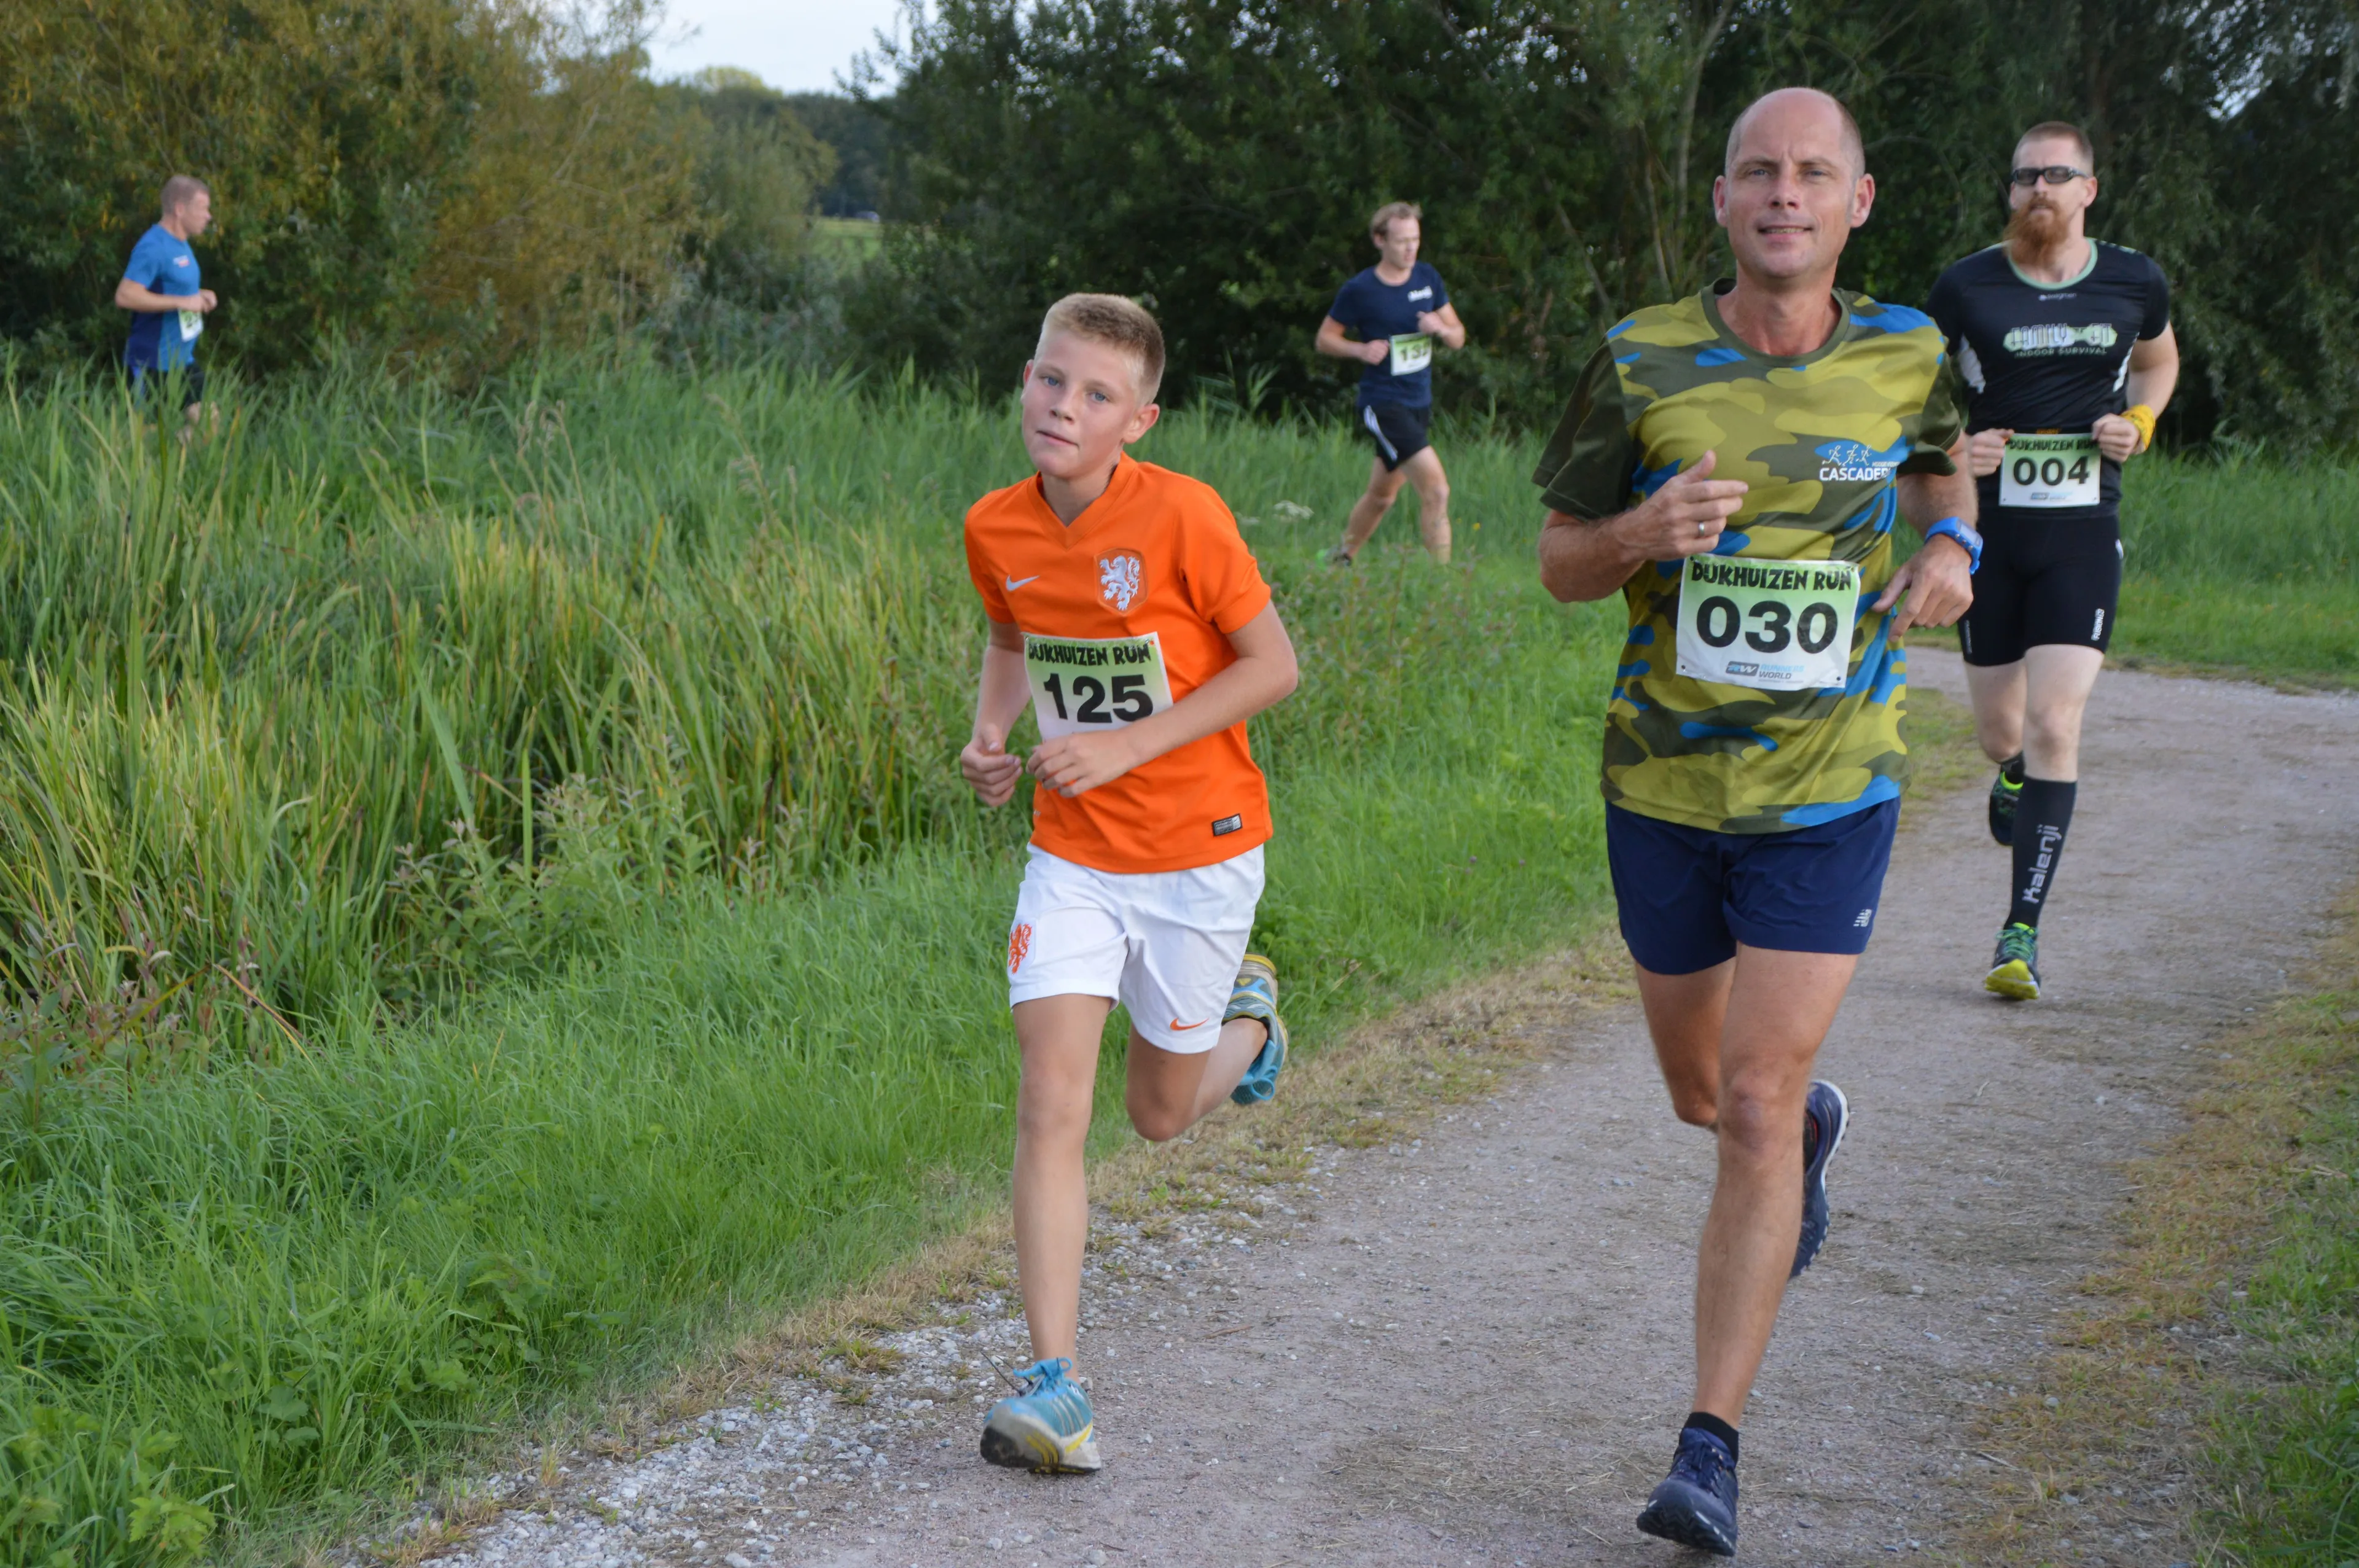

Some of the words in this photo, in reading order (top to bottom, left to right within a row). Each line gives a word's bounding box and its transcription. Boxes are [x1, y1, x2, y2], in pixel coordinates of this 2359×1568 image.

[2016, 348, 2055, 357] INDOOR
[2058, 346, 2107, 355] SURVIVAL
[2013, 456, 2090, 486] 004
[1813, 569, 1851, 591] RUN
[1696, 596, 1838, 654] 030
[1113, 644, 1151, 665] RUN
[1759, 671, 1792, 680] WORLD
[1043, 673, 1153, 723] 125
